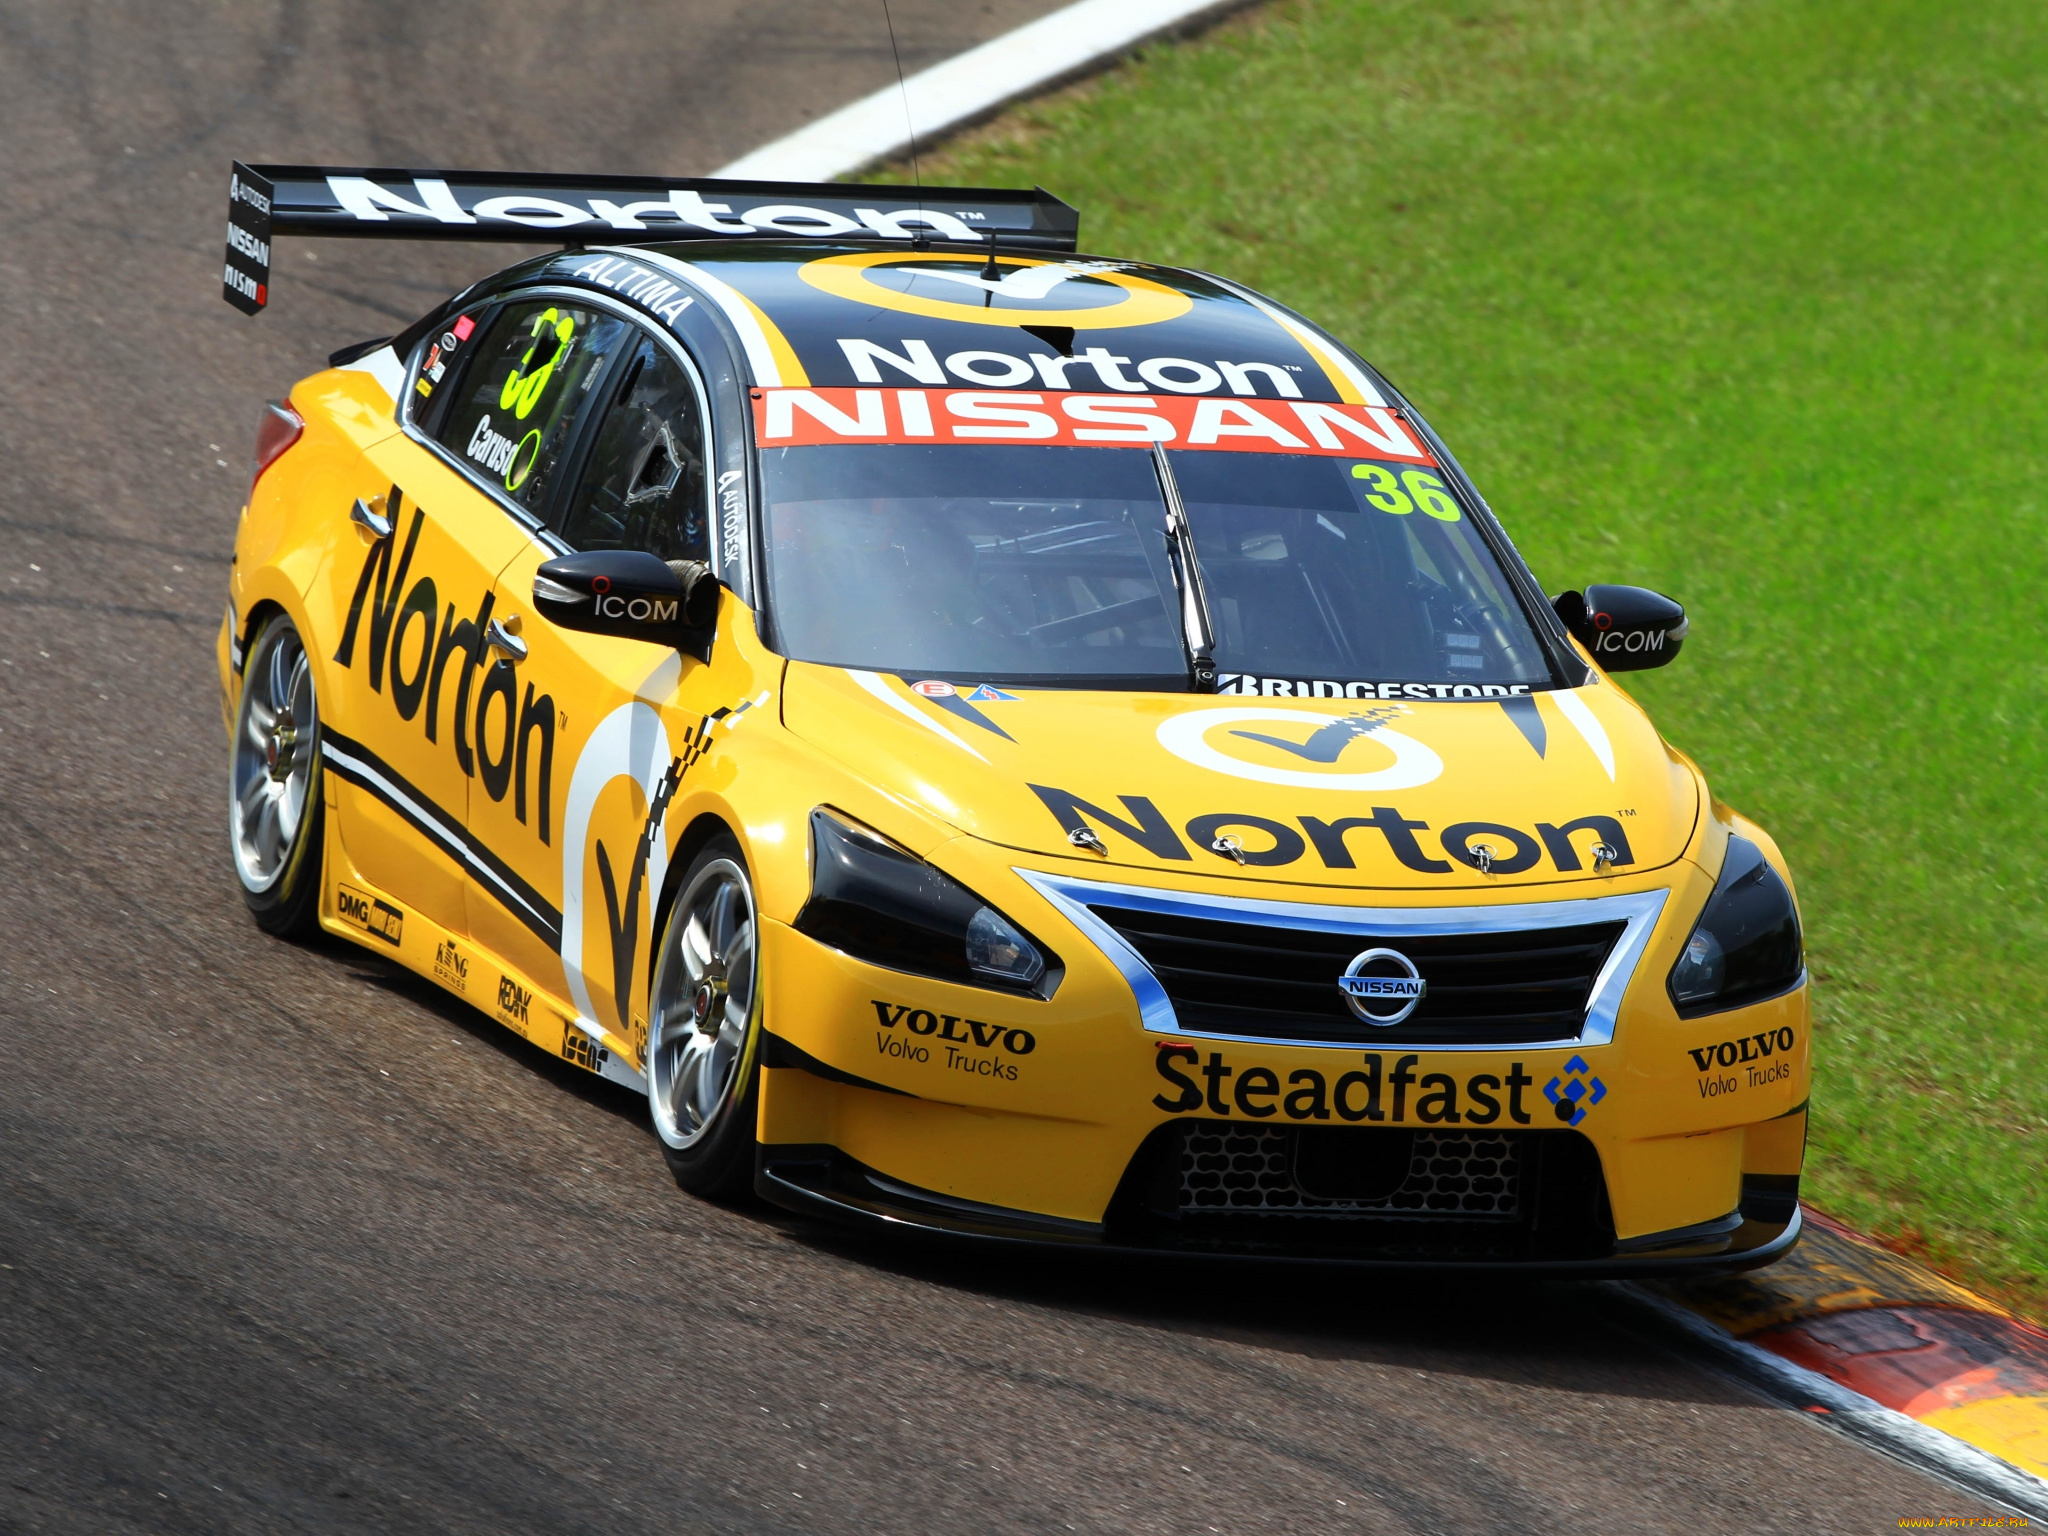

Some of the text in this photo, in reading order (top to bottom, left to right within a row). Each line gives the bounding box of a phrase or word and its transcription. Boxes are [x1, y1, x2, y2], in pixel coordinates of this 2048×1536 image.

[325, 176, 984, 241] Norton
[226, 222, 270, 267] NISSAN
[573, 257, 695, 327] ALTIMA
[836, 338, 1303, 398] Norton
[765, 390, 1424, 459] NISSAN
[1352, 463, 1461, 522] 36
[723, 490, 739, 568] AUTODESK
[595, 594, 678, 621] ICOM
[333, 484, 555, 848] Norton
[1595, 629, 1666, 652] ICOM
[1026, 782, 1635, 876] Norton
[340, 891, 369, 922] DMG
[434, 965, 466, 991] SPRINGS
[1349, 981, 1419, 994] NISSAN
[871, 1000, 1036, 1055] VOLVO
[1687, 1026, 1794, 1072] VOLVO
[877, 1031, 1019, 1081] Volvo Trucks
[1698, 1060, 1790, 1098] Volvo Trucks
[1152, 1046, 1533, 1125] Steadfast
